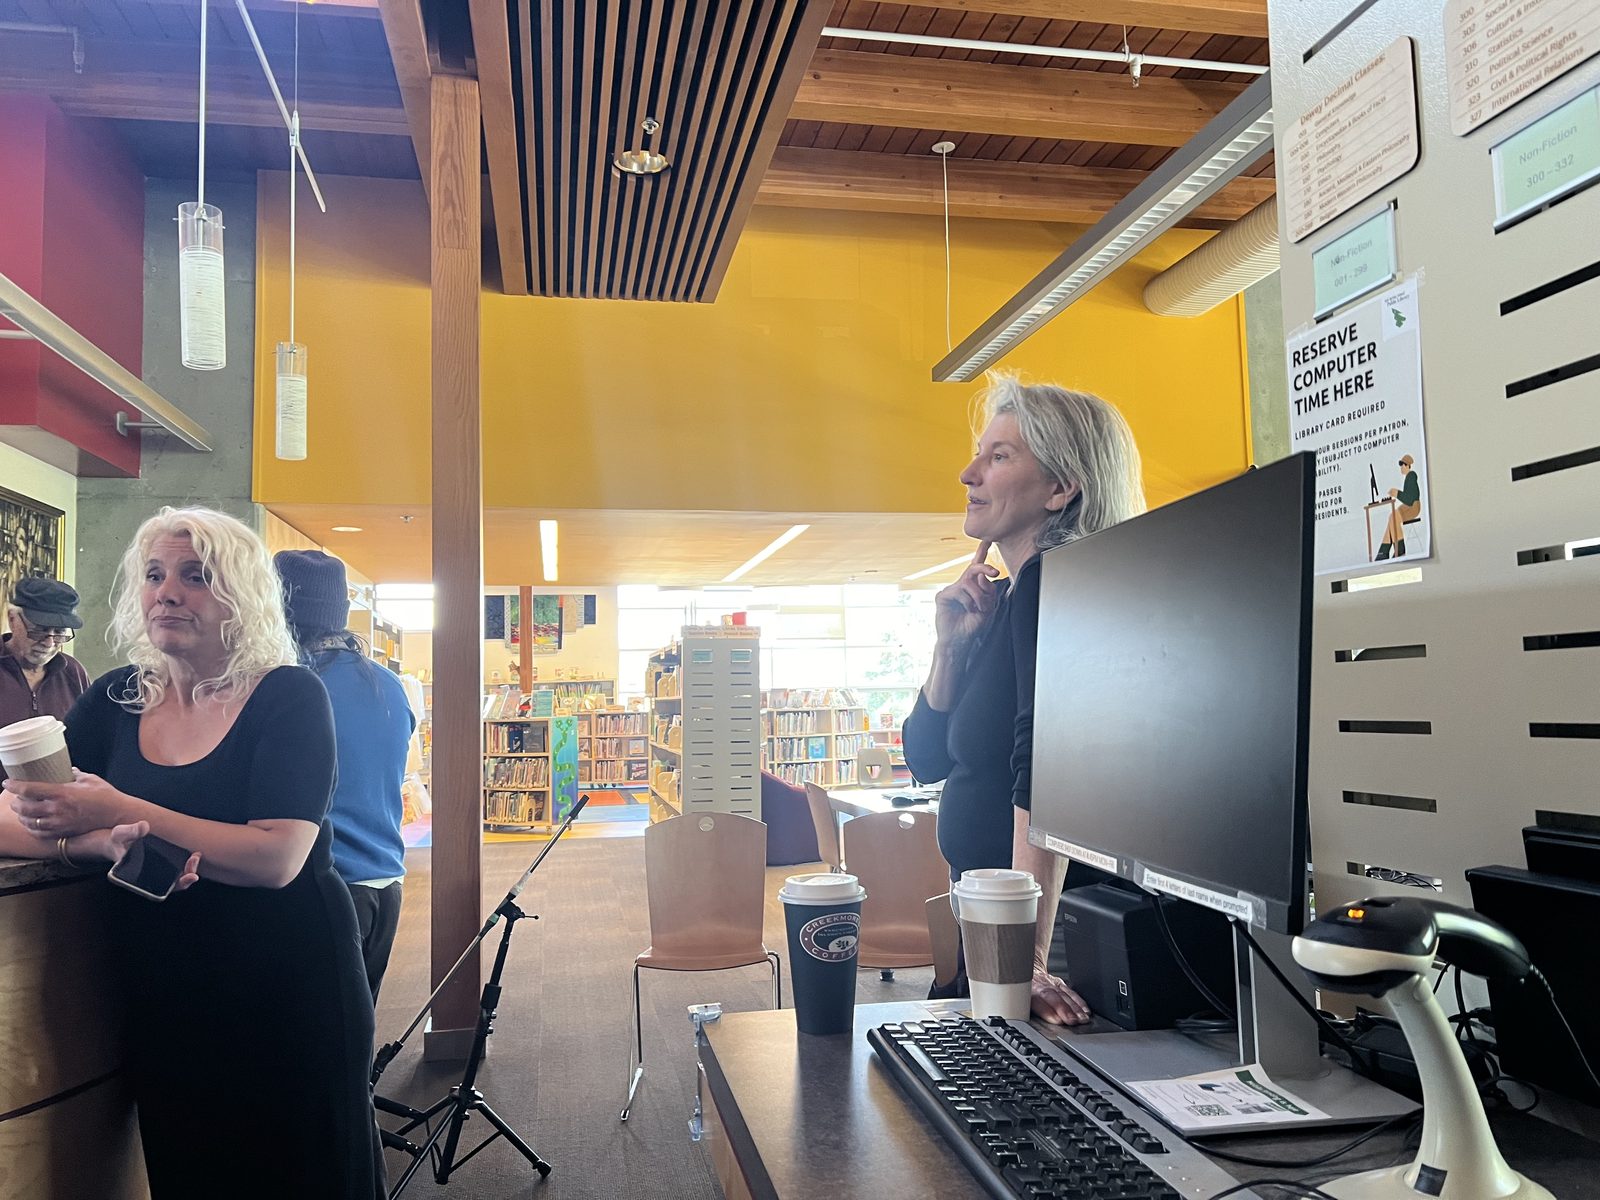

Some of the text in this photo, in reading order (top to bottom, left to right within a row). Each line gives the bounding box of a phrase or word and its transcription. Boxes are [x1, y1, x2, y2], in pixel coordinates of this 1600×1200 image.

[1459, 7, 1475, 24] 300
[1462, 23, 1476, 39] 302
[1462, 41, 1478, 57] 306
[1486, 13, 1514, 38] Culture
[1515, 7, 1522, 18] &
[1465, 26, 1524, 73] 310 Statistics
[1466, 25, 1554, 90] 320 Political Science
[1468, 30, 1578, 107] 323 Civil & Political Rights
[1469, 46, 1584, 124] 327 International Relations
[1300, 53, 1386, 126] Dewey Decimal Classes:
[1381, 134, 1410, 157] Philosophy
[1519, 126, 1577, 164] Non-Fiction
[1356, 166, 1382, 187] Philosophy
[1526, 170, 1544, 188] 300
[1554, 153, 1574, 172] 332
[1330, 239, 1372, 268] Non-Fiction
[1292, 322, 1358, 368] RESERVE
[1293, 341, 1377, 392] COMPUTER
[1294, 369, 1375, 416] TIME HERE
[1294, 400, 1386, 440] LIBRARY CARD REQUIRED
[1322, 449, 1352, 465] (SUBJECT
[1354, 445, 1362, 454] TO
[1363, 433, 1400, 451] COMPUTER
[1331, 432, 1363, 450] SESSIONS
[1364, 427, 1377, 439] PER
[1319, 485, 1342, 498] PASSES
[1330, 497, 1343, 507] FOR
[1195, 890, 1209, 902] name
[1209, 894, 1222, 906] when
[1222, 899, 1248, 914] prompted
